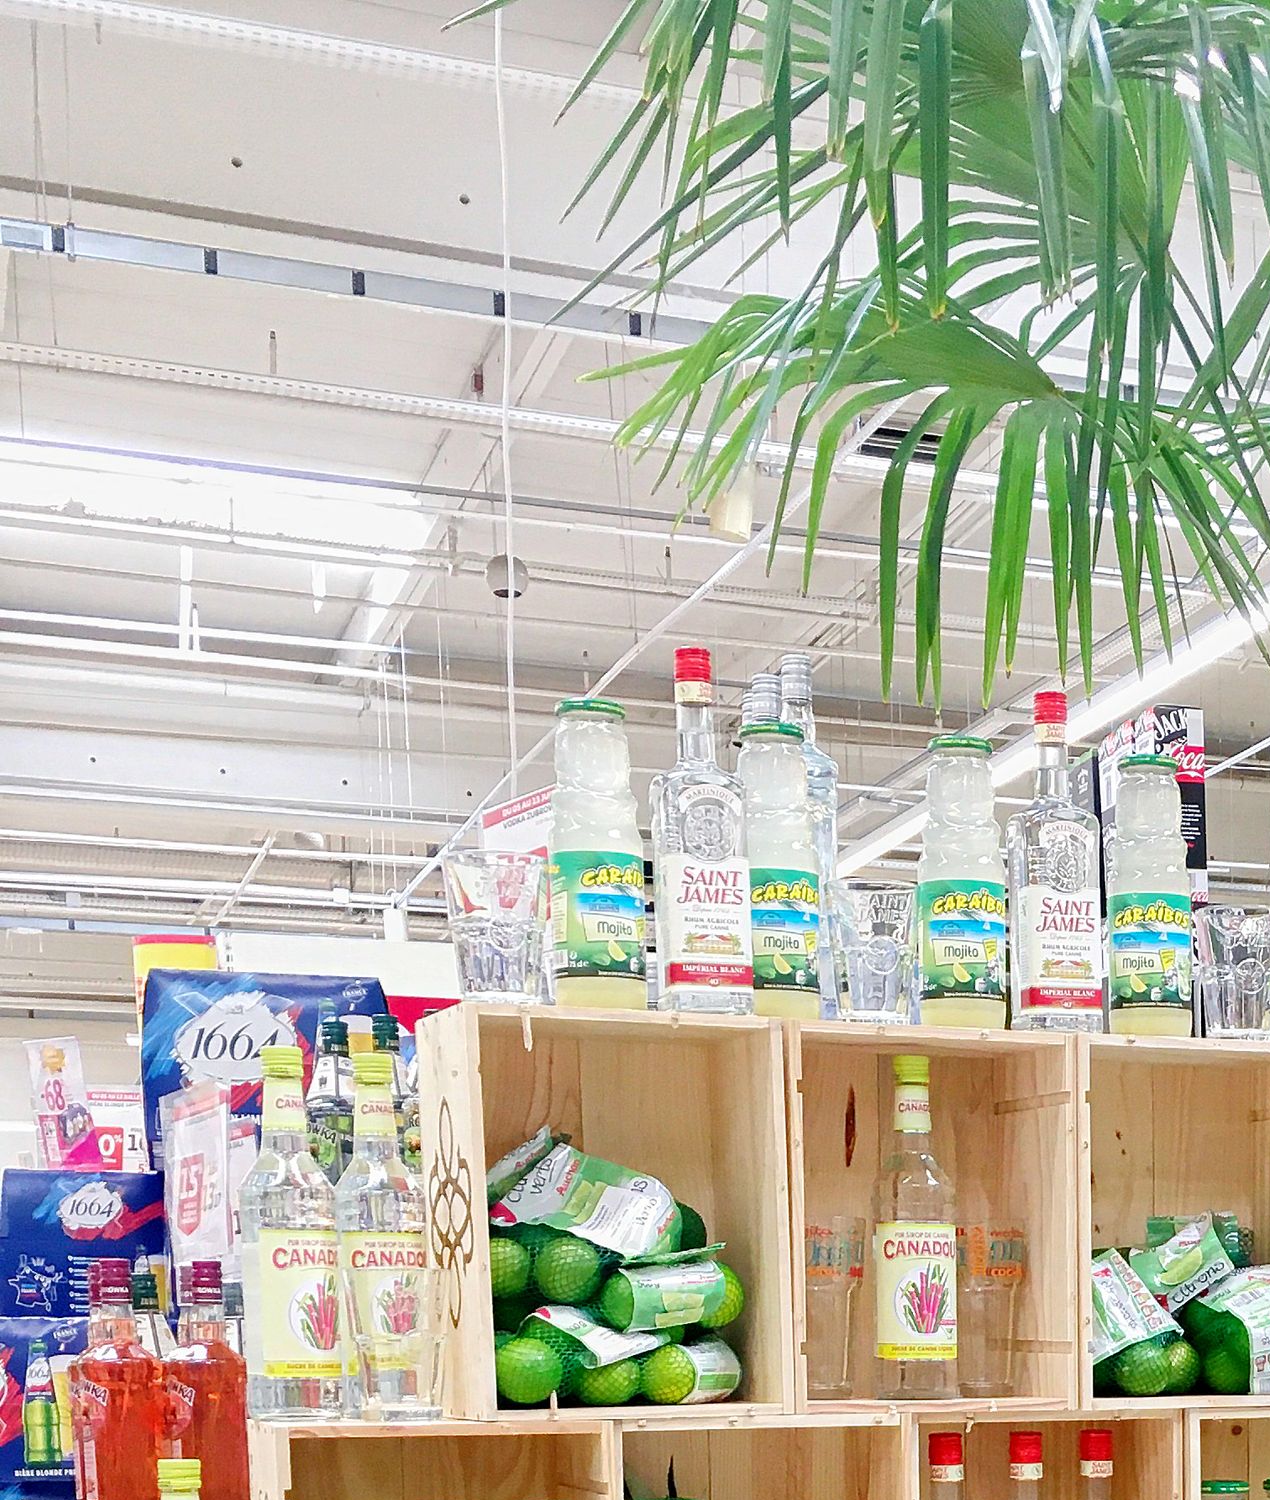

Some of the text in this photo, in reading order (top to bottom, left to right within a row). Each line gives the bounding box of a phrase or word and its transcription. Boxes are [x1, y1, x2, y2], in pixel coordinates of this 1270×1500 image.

[1154, 707, 1189, 741] JACK
[682, 866, 742, 888] SAINT
[676, 884, 744, 905] JAMES
[1040, 897, 1095, 917] SAINT
[1036, 915, 1096, 933] JAMES
[763, 935, 799, 951] Mojito
[944, 945, 979, 960] Mojito
[1122, 954, 1155, 971] Mojito
[191, 1021, 279, 1061] 1664
[70, 1199, 113, 1217] 1664
[1171, 1260, 1226, 1305] Citrons
